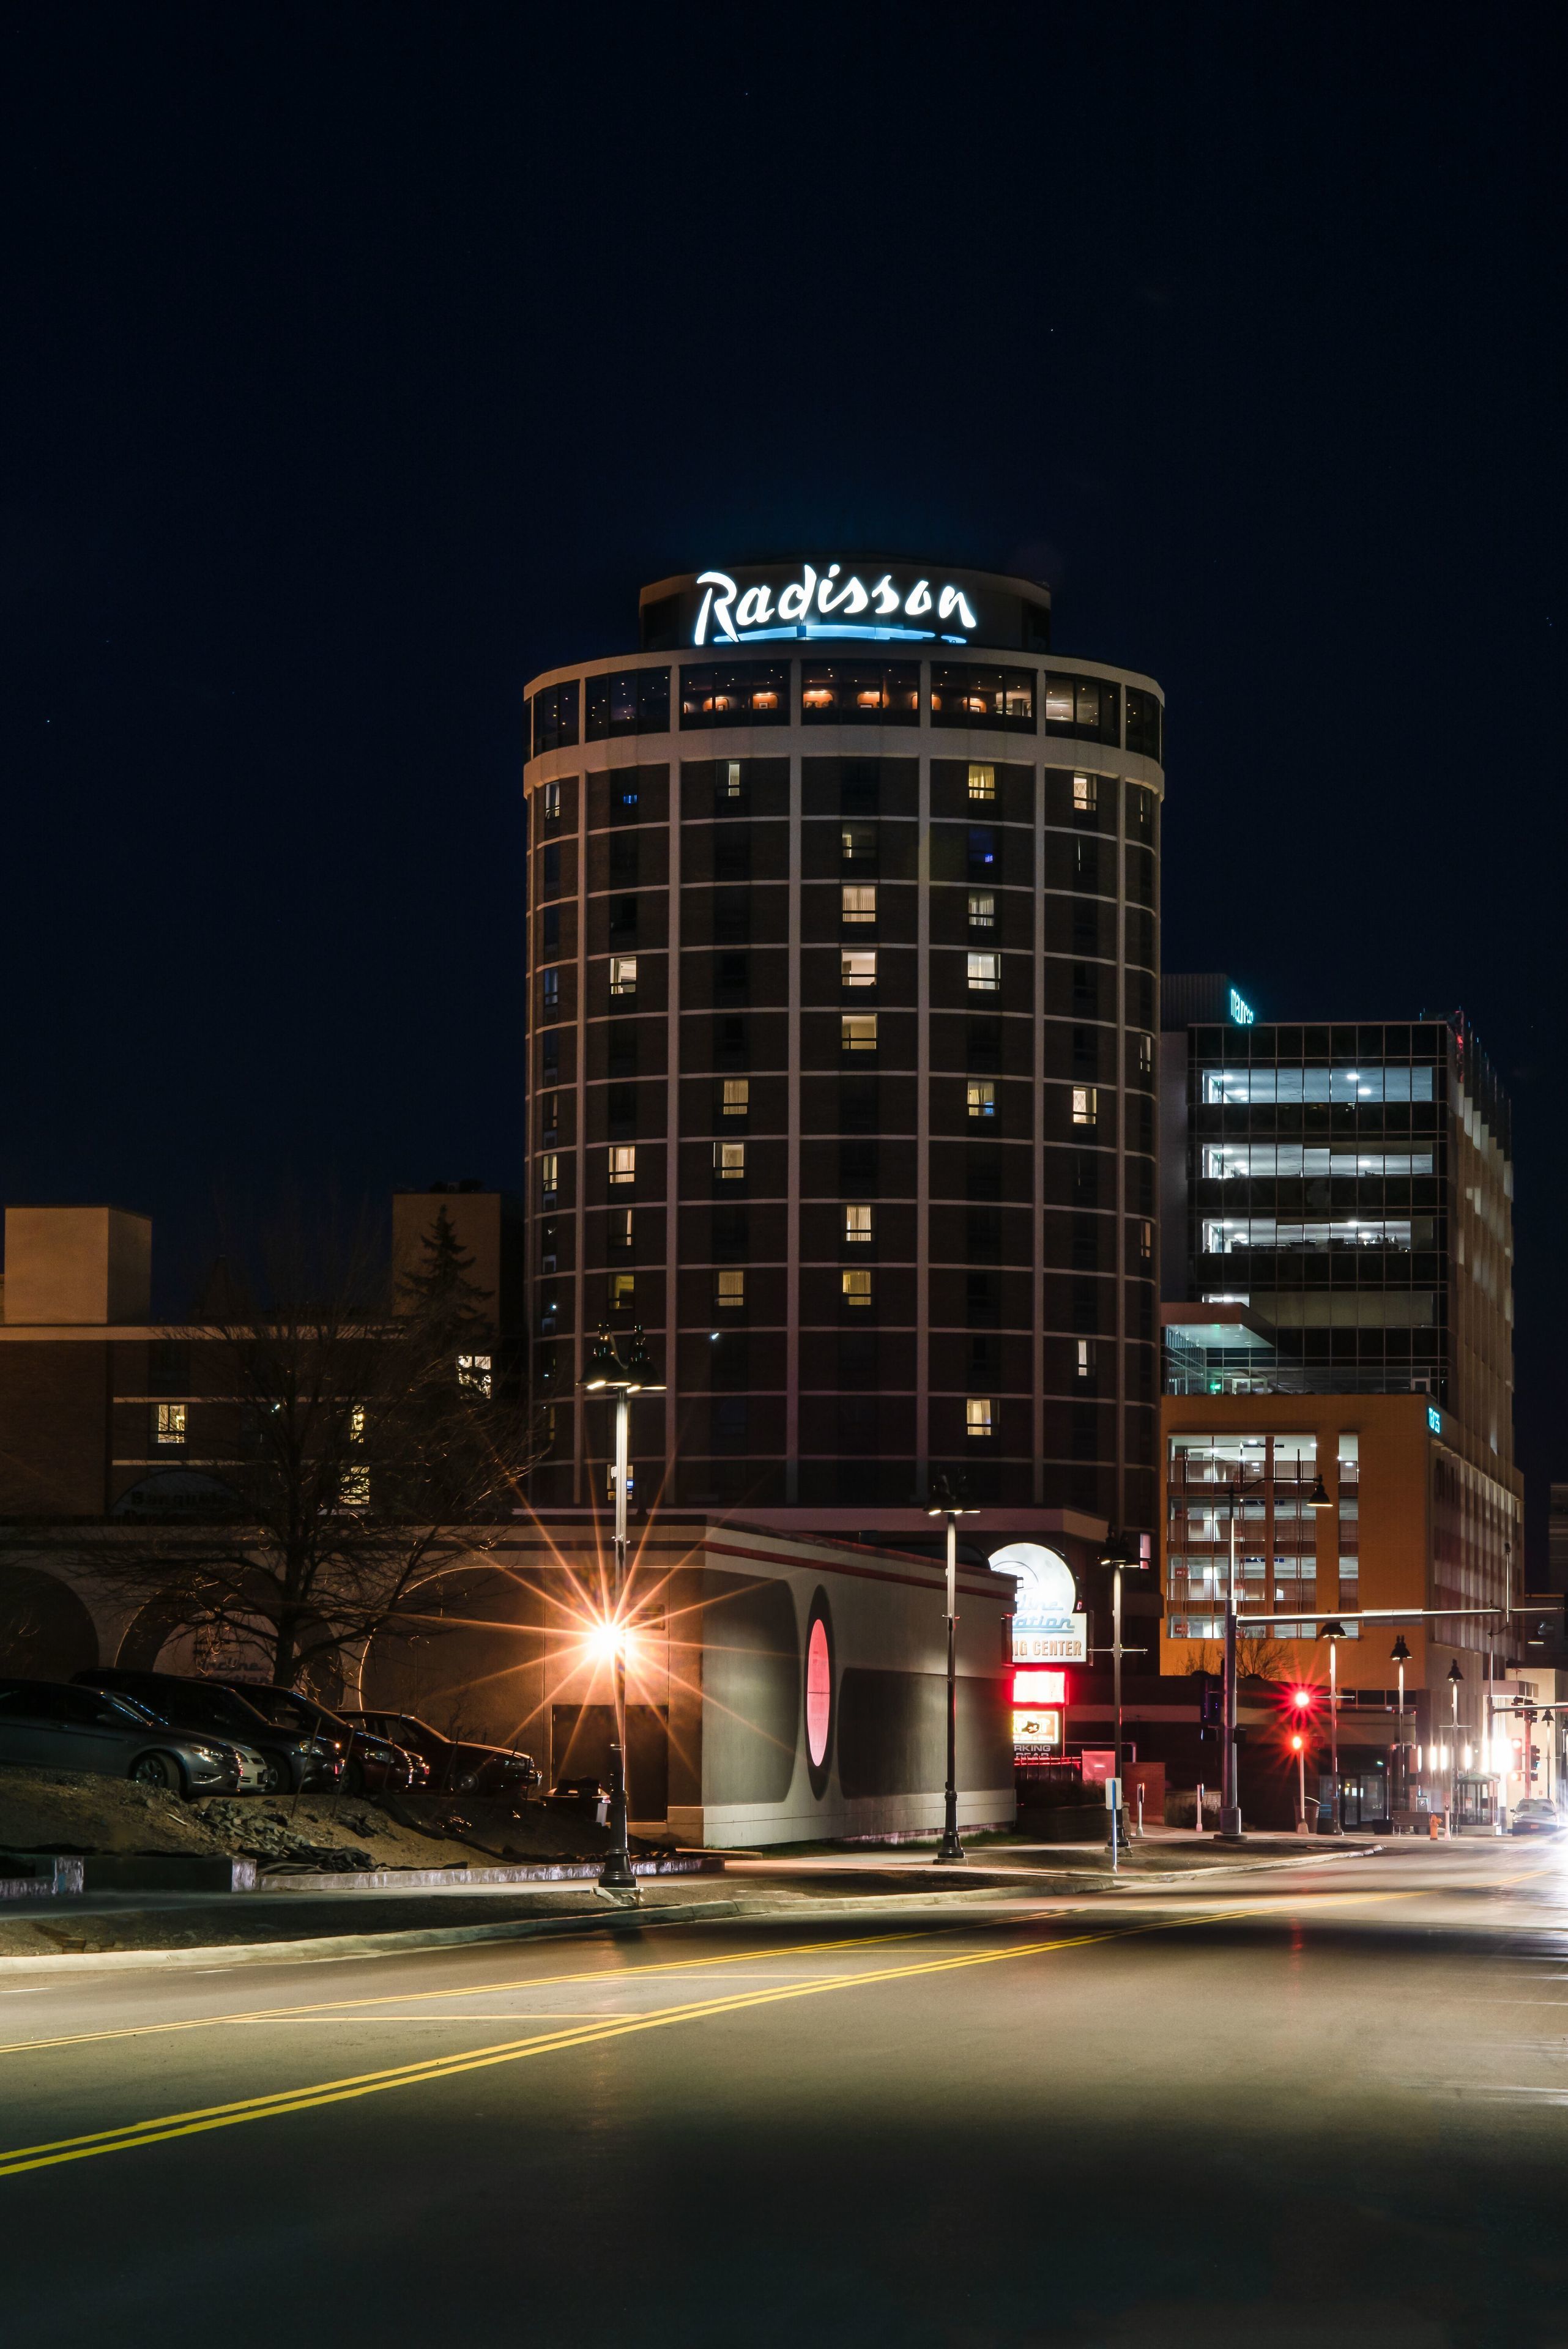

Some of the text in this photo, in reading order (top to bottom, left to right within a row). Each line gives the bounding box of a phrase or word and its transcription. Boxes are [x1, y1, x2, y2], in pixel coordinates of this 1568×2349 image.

[694, 563, 977, 645] Radisson
[1013, 1616, 1076, 1628] ation
[1033, 1640, 1082, 1657] CENTER
